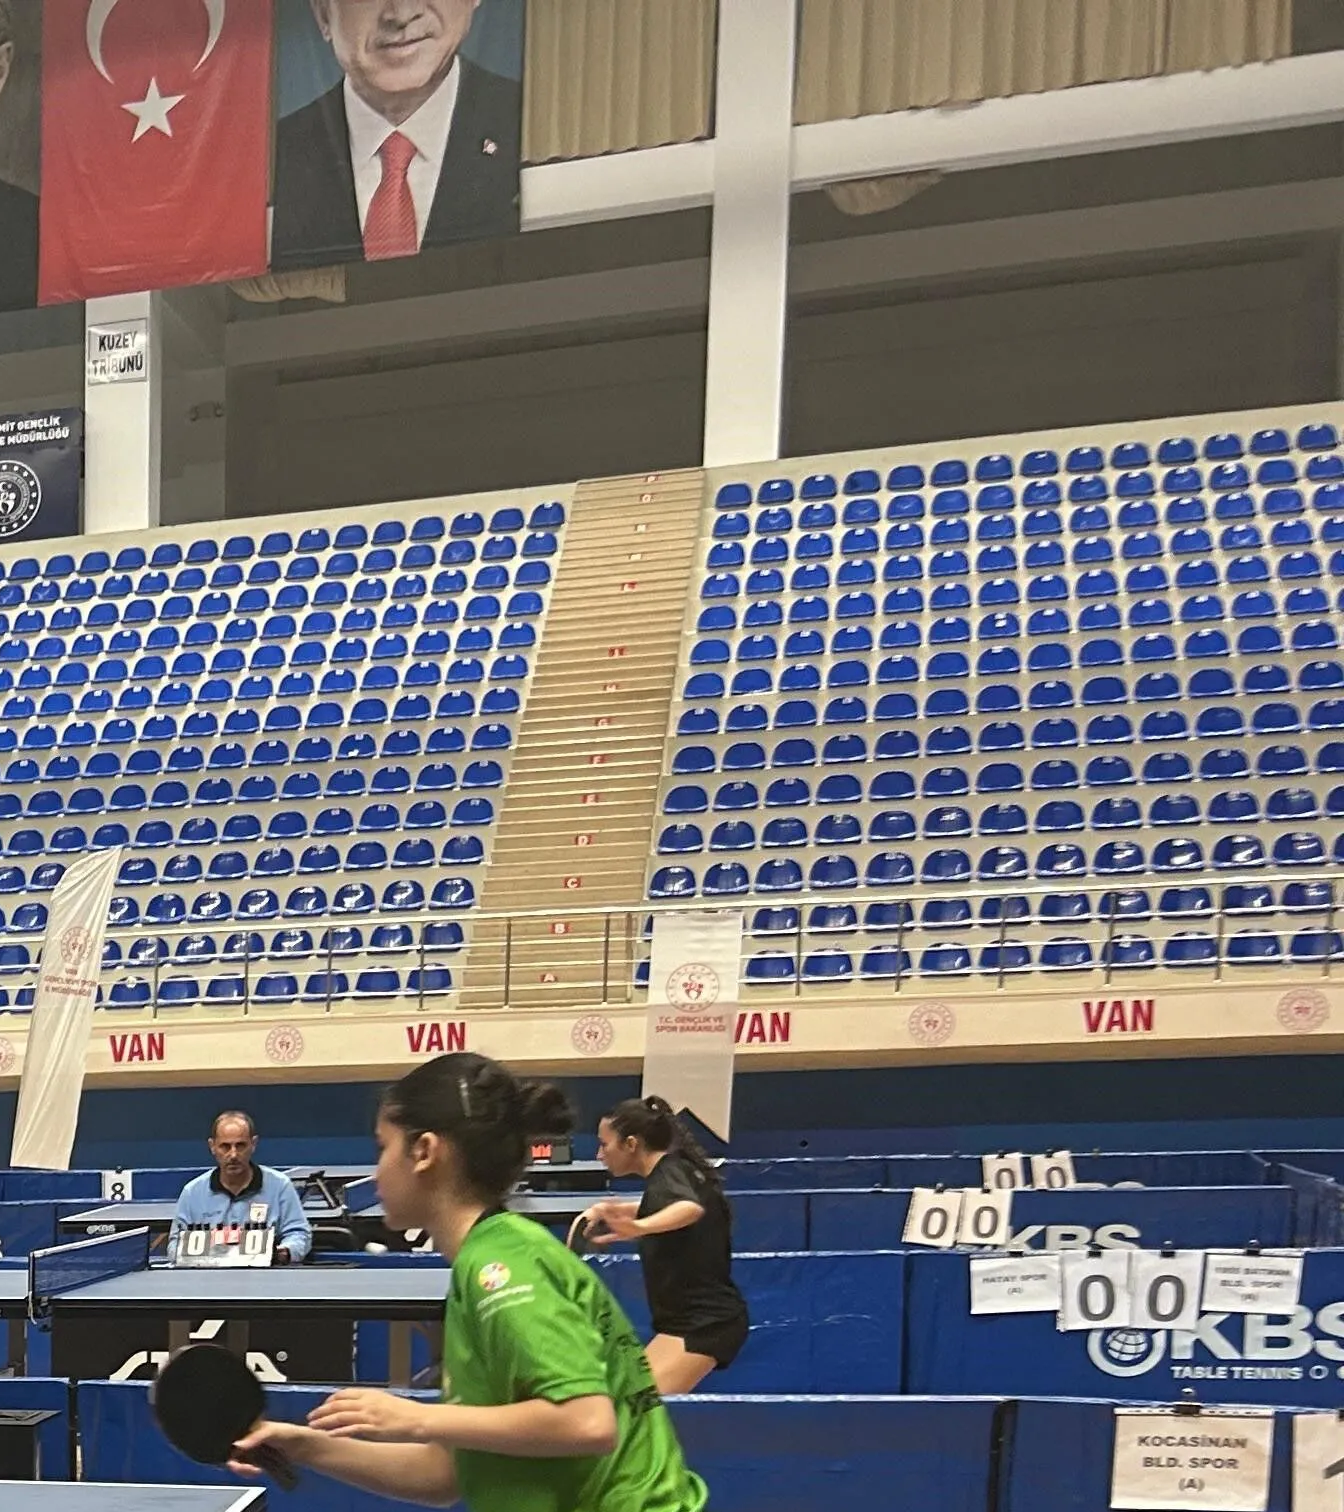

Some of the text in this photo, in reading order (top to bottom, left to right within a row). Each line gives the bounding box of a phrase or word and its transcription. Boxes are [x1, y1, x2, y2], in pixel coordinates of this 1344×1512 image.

[98, 330, 138, 352] KUZEY
[1083, 1000, 1155, 1034] VAN
[109, 1032, 165, 1063] VAN
[407, 1022, 467, 1053] VAN
[112, 1182, 125, 1200] 8
[921, 1205, 999, 1240] 0 0
[187, 1229, 263, 1256] 0 0
[1078, 1274, 1185, 1322] 0 0
[1170, 1366, 1303, 1380] TABLE TENNIS
[1137, 1434, 1248, 1449] KOCASİNAN
[1142, 1456, 1240, 1470] BLD. SPOR
[1178, 1478, 1205, 1492] (A)
